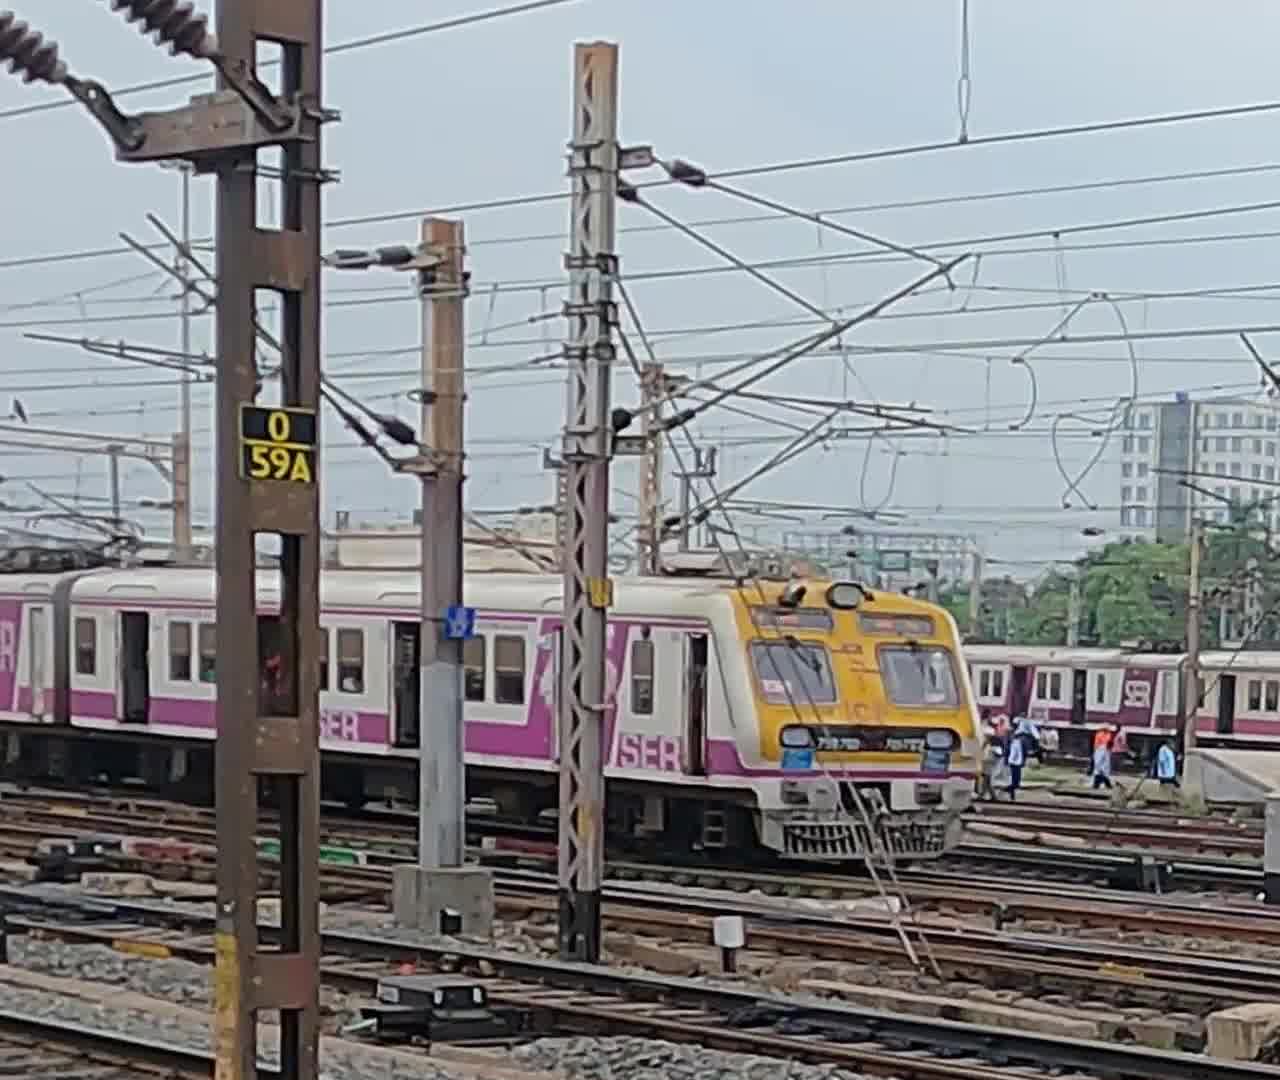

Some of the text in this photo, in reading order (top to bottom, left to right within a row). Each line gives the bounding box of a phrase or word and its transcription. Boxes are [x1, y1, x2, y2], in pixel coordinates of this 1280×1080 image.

[268, 411, 291, 442] 0
[249, 447, 311, 482] 59A
[619, 733, 681, 770] SER
